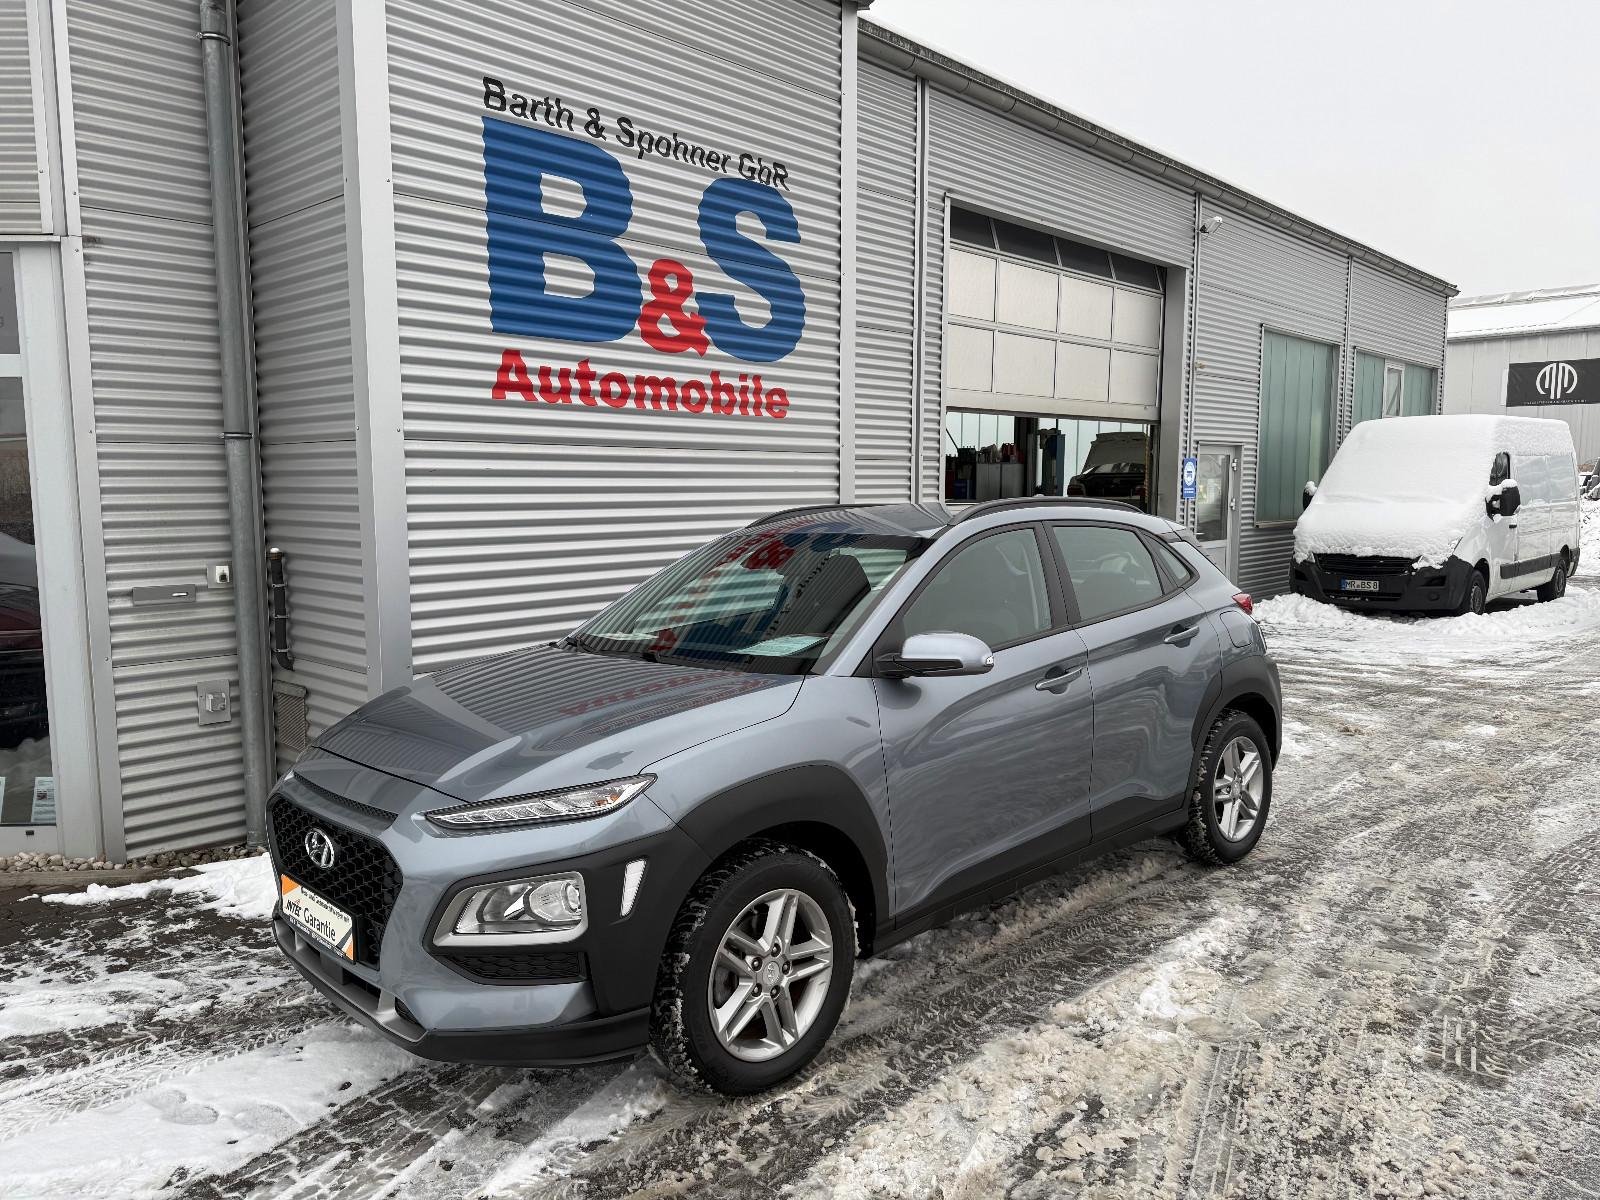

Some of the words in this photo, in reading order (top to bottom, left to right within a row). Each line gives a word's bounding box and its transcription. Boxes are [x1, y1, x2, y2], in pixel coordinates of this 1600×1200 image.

[483, 77, 574, 132] Barth
[584, 108, 607, 141] &
[616, 117, 732, 173] Spohner
[738, 152, 791, 191] GbR
[482, 115, 806, 363] B&S
[491, 348, 790, 419] Automobile
[303, 907, 336, 942] Garantie
